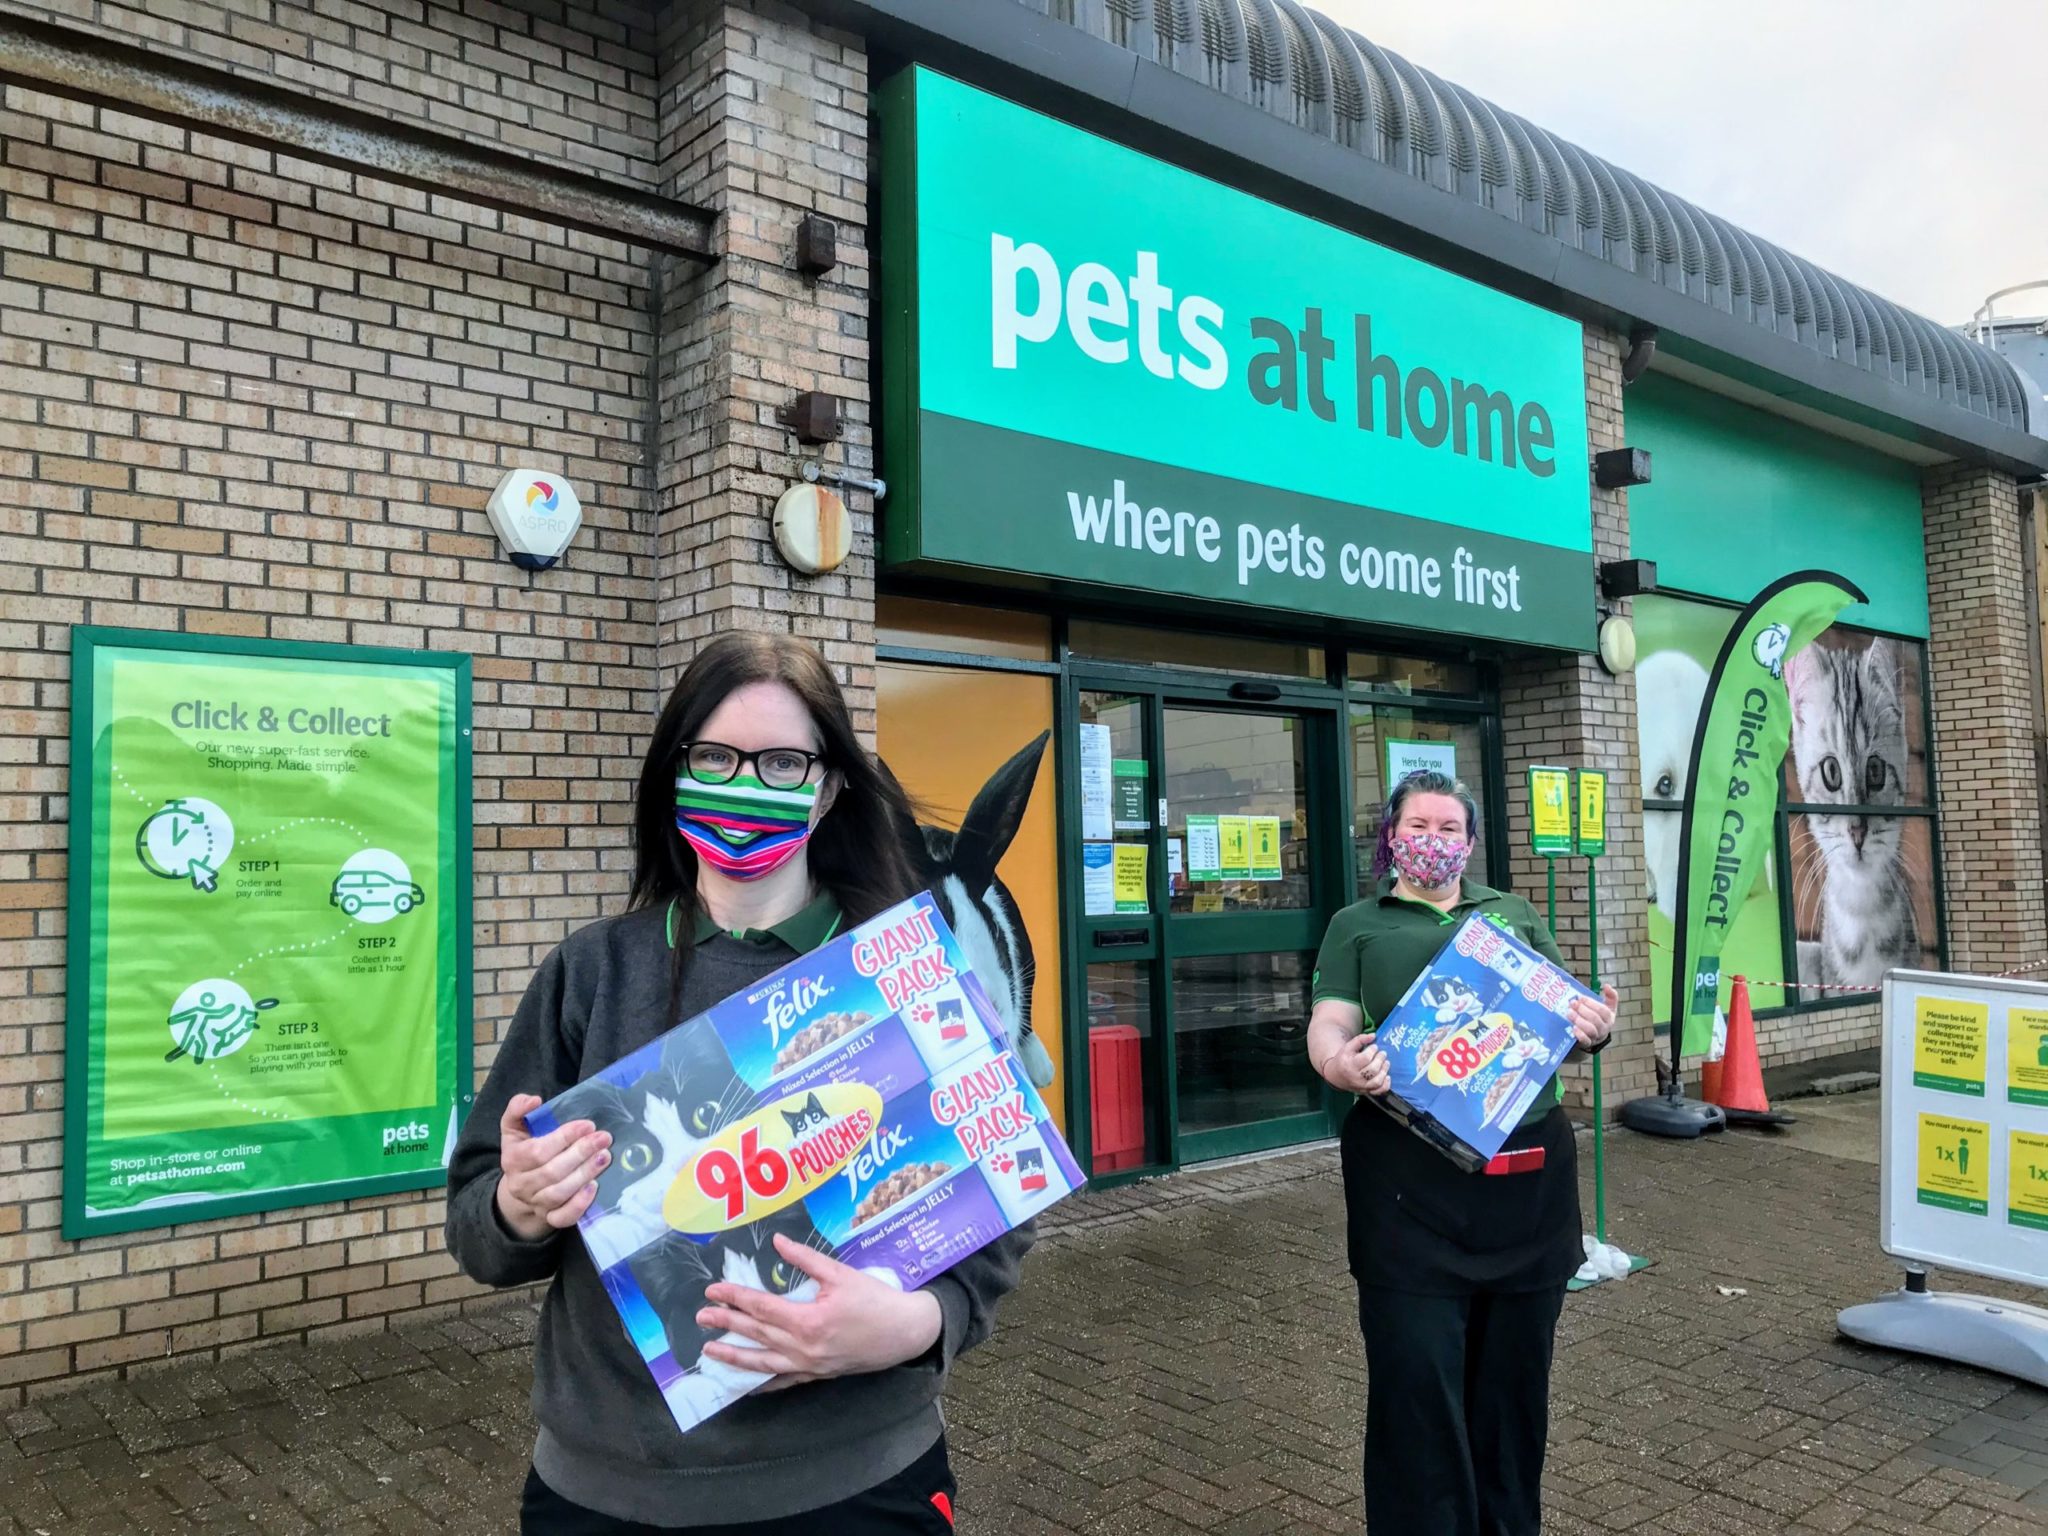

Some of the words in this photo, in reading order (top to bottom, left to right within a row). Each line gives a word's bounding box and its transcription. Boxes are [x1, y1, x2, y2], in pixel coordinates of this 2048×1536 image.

[991, 232, 1229, 390] pets
[1248, 306, 1336, 423] at
[1355, 314, 1555, 478] home
[519, 515, 568, 533] ASPRO
[1067, 479, 1221, 563] where
[1238, 523, 1325, 585] pets
[1340, 542, 1441, 598] come
[1451, 547, 1522, 612] first
[171, 700, 249, 731] Click
[257, 706, 279, 733] &
[288, 707, 391, 737] Collect
[1733, 687, 1768, 769] Click
[195, 741, 221, 753] Our
[227, 744, 255, 754] new
[259, 744, 320, 758] super-fast
[208, 757, 273, 773] Shopping.
[277, 759, 312, 771] Made
[316, 761, 358, 775] simple.
[1402, 757, 1417, 768] Here
[1418, 756, 1427, 768] for
[1429, 760, 1442, 770] you
[1728, 775, 1749, 800] &
[239, 861, 270, 872] STEP
[273, 861, 280, 872] 1
[1705, 810, 1744, 929] Collect
[236, 880, 263, 888] Order
[265, 879, 282, 887] and
[236, 889, 253, 899] pay
[254, 888, 282, 897] online
[358, 938, 387, 949] STEP
[389, 937, 396, 948] 2
[853, 907, 936, 975] GIANT
[1457, 918, 1490, 956] GIANT
[1474, 931, 1504, 966] PACK
[352, 955, 381, 964] Collect
[382, 955, 391, 963] in
[348, 965, 367, 974] little
[386, 964, 406, 973] hour
[878, 947, 955, 1010] PACK
[1522, 962, 1555, 1000] GIANT
[1539, 976, 1568, 1011] PACK
[1926, 1011, 1949, 1020] Please
[1960, 1015, 1976, 1024] kind
[278, 1023, 308, 1035] STEP
[311, 1022, 319, 1033] 3
[1927, 1029, 1964, 1040] colleagues
[1937, 1023, 1965, 1032] support
[265, 1043, 291, 1052] There
[1437, 1037, 1481, 1079] 88
[1477, 1023, 1510, 1058] POUCHES
[1922, 1036, 1938, 1046] they
[1952, 1041, 1979, 1053] helping
[1925, 1047, 1958, 1057] everyone
[1959, 1051, 1975, 1060] stay
[248, 1055, 260, 1063] So
[262, 1055, 279, 1064] you
[281, 1052, 298, 1060] can
[300, 1050, 314, 1060] get
[316, 1048, 336, 1057] back
[338, 1048, 348, 1056] to
[781, 1076, 806, 1096] Mixed
[805, 1058, 840, 1081] Selection
[840, 1053, 848, 1063] in
[846, 1032, 876, 1059] JELLY
[250, 1063, 284, 1075] playing
[286, 1061, 306, 1070] with
[308, 1060, 327, 1070] your
[931, 1053, 1015, 1123] GIANT
[383, 1121, 429, 1147] pets
[956, 1094, 1033, 1159] PACK
[1936, 1121, 1950, 1129] must
[1951, 1124, 1965, 1132] shop
[1966, 1126, 1982, 1134] alone
[384, 1144, 395, 1156] at
[398, 1142, 429, 1154] home
[2017, 1137, 2028, 1145] You
[111, 1158, 146, 1172] Shop
[150, 1151, 200, 1167] in-store
[204, 1150, 218, 1159] or
[222, 1144, 263, 1157] online
[1936, 1146, 1954, 1162] 1x
[110, 1174, 123, 1186] at
[127, 1161, 246, 1187] petsathome.com
[695, 1124, 789, 1224] 96
[788, 1108, 873, 1183] POUCHES
[2028, 1165, 2048, 1181] 1x
[860, 1230, 886, 1250] Mixed
[884, 1210, 919, 1234] Selection
[919, 1204, 928, 1215] in
[925, 1183, 955, 1211] JELLY
